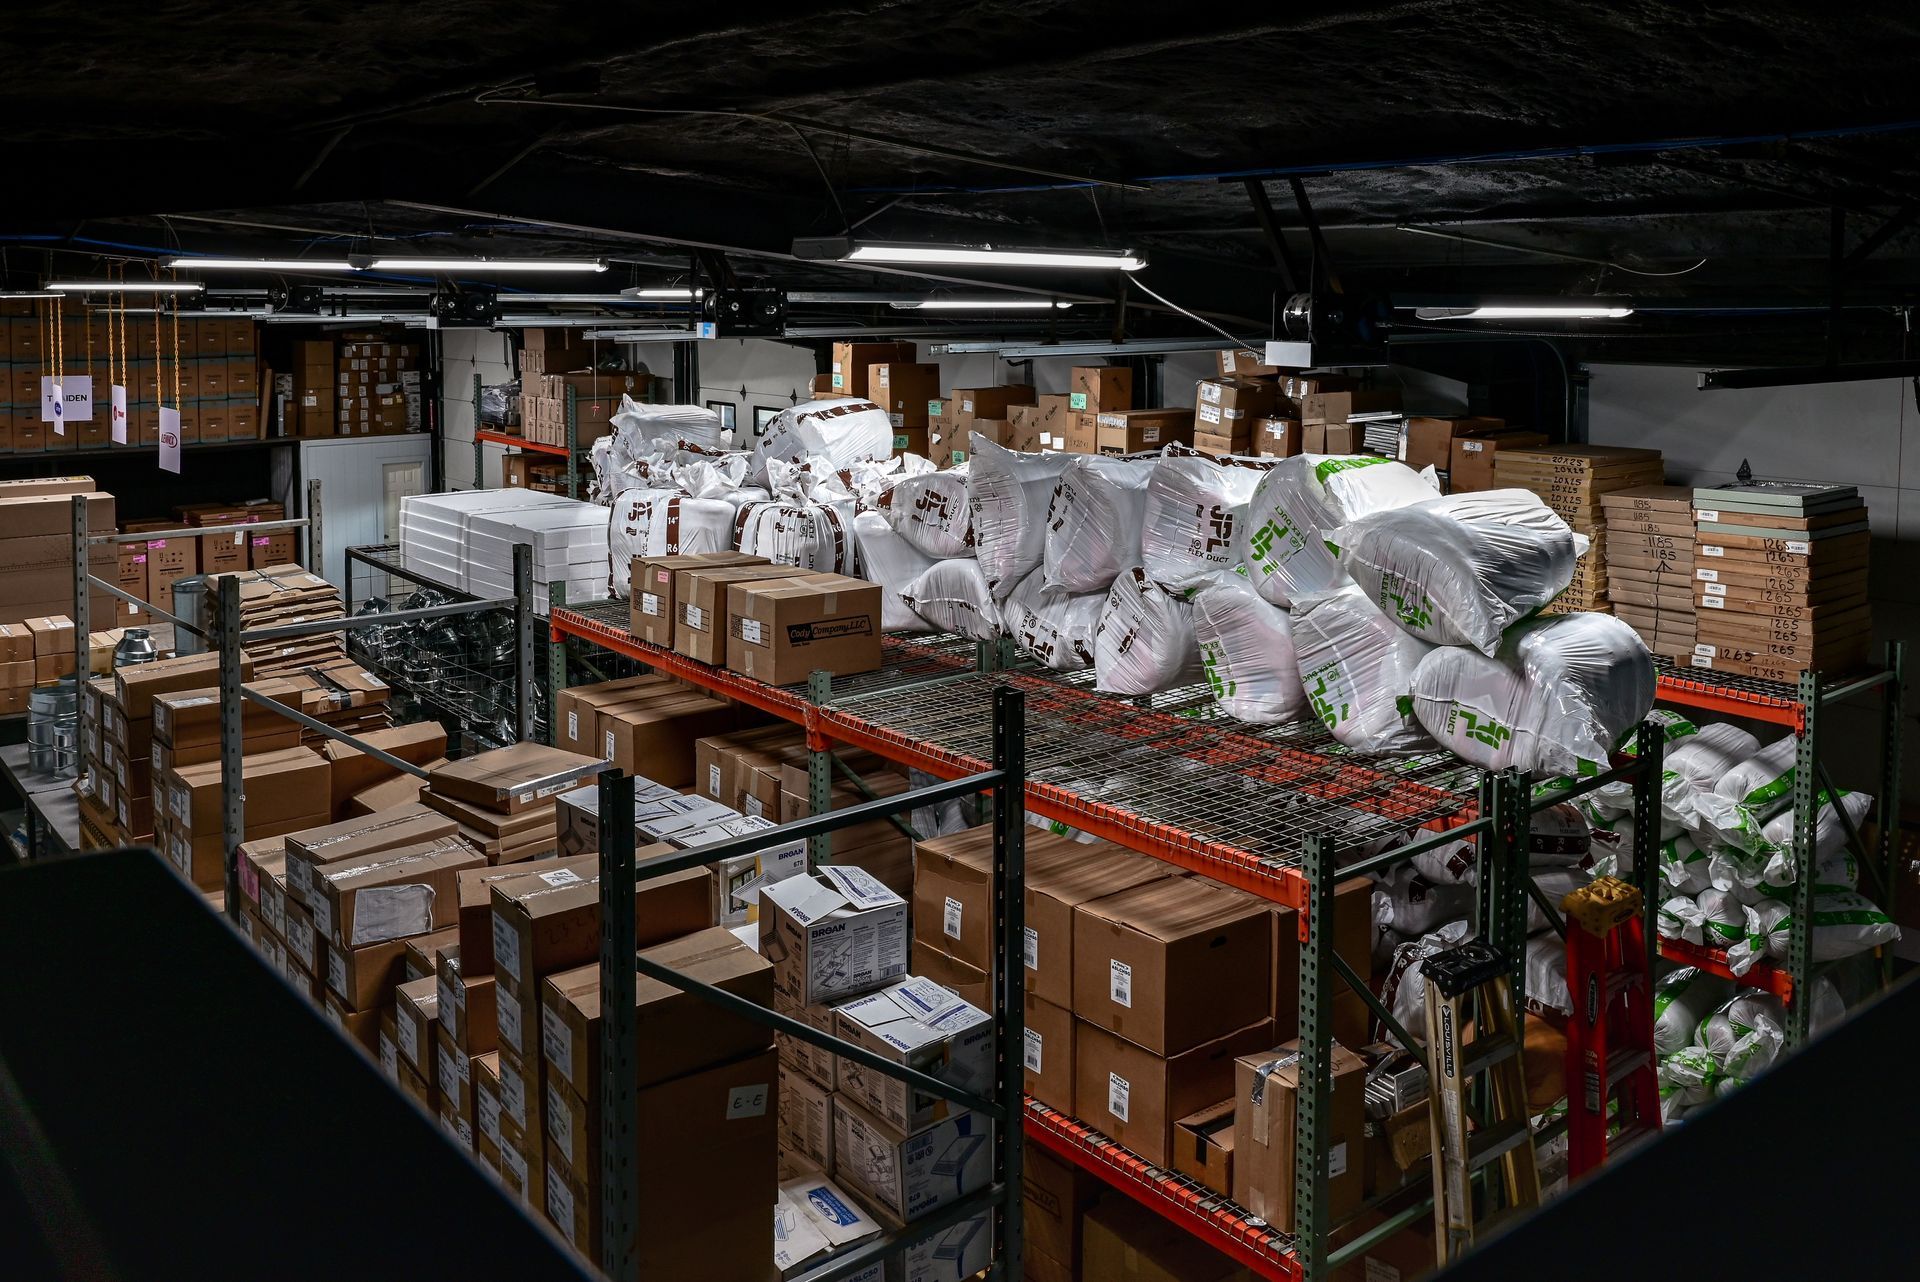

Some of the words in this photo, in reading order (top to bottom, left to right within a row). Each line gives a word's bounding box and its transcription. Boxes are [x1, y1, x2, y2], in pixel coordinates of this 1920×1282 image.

[915, 489, 948, 520] JPL
[1634, 500, 1651, 510] 1185
[1274, 505, 1292, 527] DUCT
[1633, 512, 1650, 521] 1185
[1206, 504, 1233, 553] JPL
[1641, 523, 1660, 533] 1185
[667, 543, 678, 553] R6
[1250, 518, 1289, 562] JPL
[1187, 547, 1204, 559] FLEX
[1206, 554, 1229, 564] DUCT
[1766, 551, 1794, 563] 1265
[1771, 566, 1801, 578] 1265
[1382, 573, 1391, 593] FLEX
[1766, 578, 1795, 591] 1265
[1379, 592, 1389, 610] DUCT
[1760, 591, 1792, 603] 1265
[1774, 606, 1802, 617] 1265
[790, 627, 811, 638] Cody
[1771, 618, 1799, 630] 1265
[1769, 630, 1798, 641] 1265
[1720, 648, 1752, 663] 1265
[1768, 644, 1795, 655] 1265
[1200, 650, 1226, 700] JPL
[1309, 676, 1338, 730] JPL
[1446, 709, 1458, 736] DUCT
[1458, 709, 1511, 750] JPL
[778, 847, 804, 861] BROAN
[789, 906, 811, 923] BROAN
[811, 922, 847, 939] BROAN
[853, 969, 873, 979] BROAN
[844, 996, 877, 1012] BROAN
[838, 1018, 861, 1039] BROAN
[963, 1027, 993, 1046] BROAN
[882, 1033, 911, 1050] BROAN
[1443, 1016, 1454, 1077] LOUISVILLE
[909, 1194, 938, 1216] BROAN
